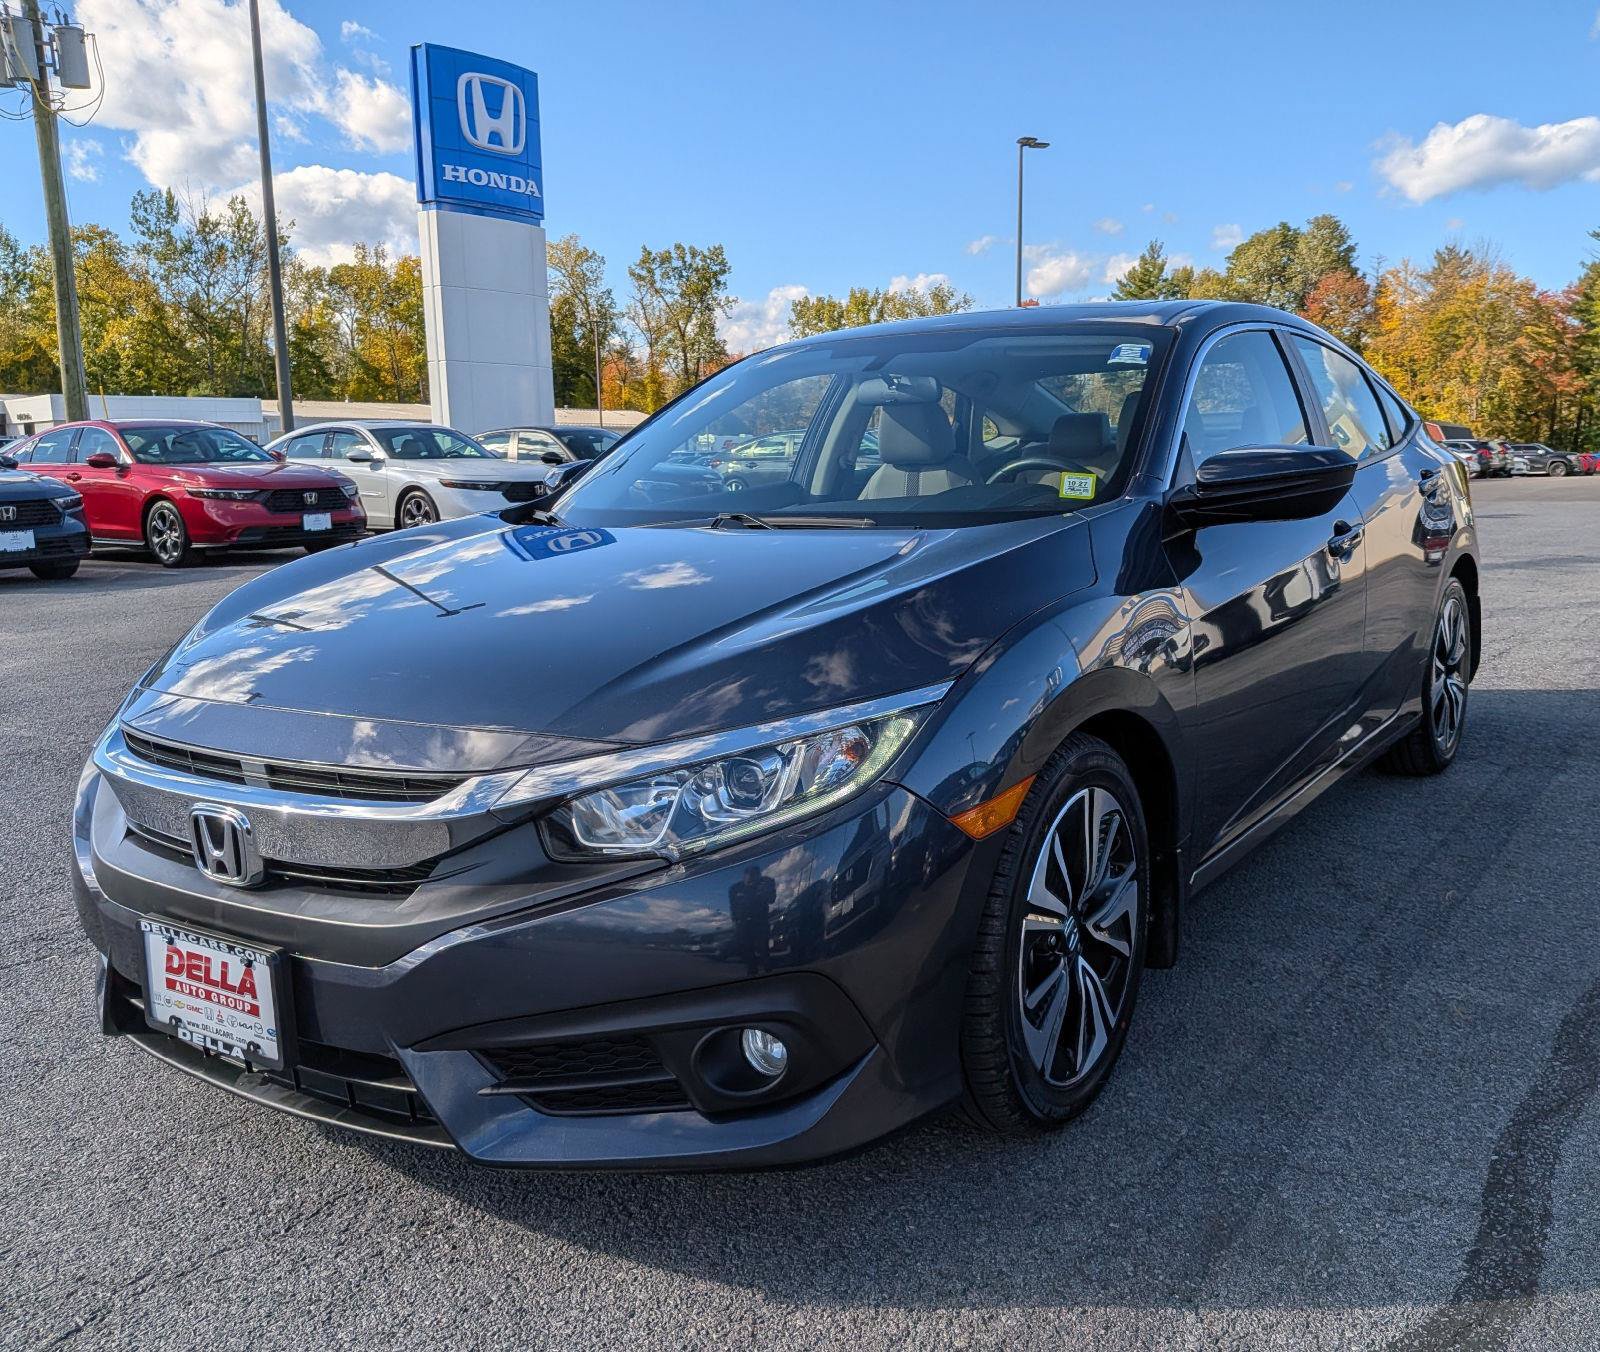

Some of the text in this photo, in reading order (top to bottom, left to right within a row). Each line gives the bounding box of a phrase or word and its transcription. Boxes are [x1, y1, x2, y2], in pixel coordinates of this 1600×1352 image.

[443, 164, 541, 197] HONDA
[140, 920, 267, 965] DELLACARS.COM
[165, 944, 258, 999] DELLA
[175, 982, 252, 1012] AUTO GROUP
[186, 1004, 204, 1014] GMC
[177, 1027, 246, 1060] DELLA
